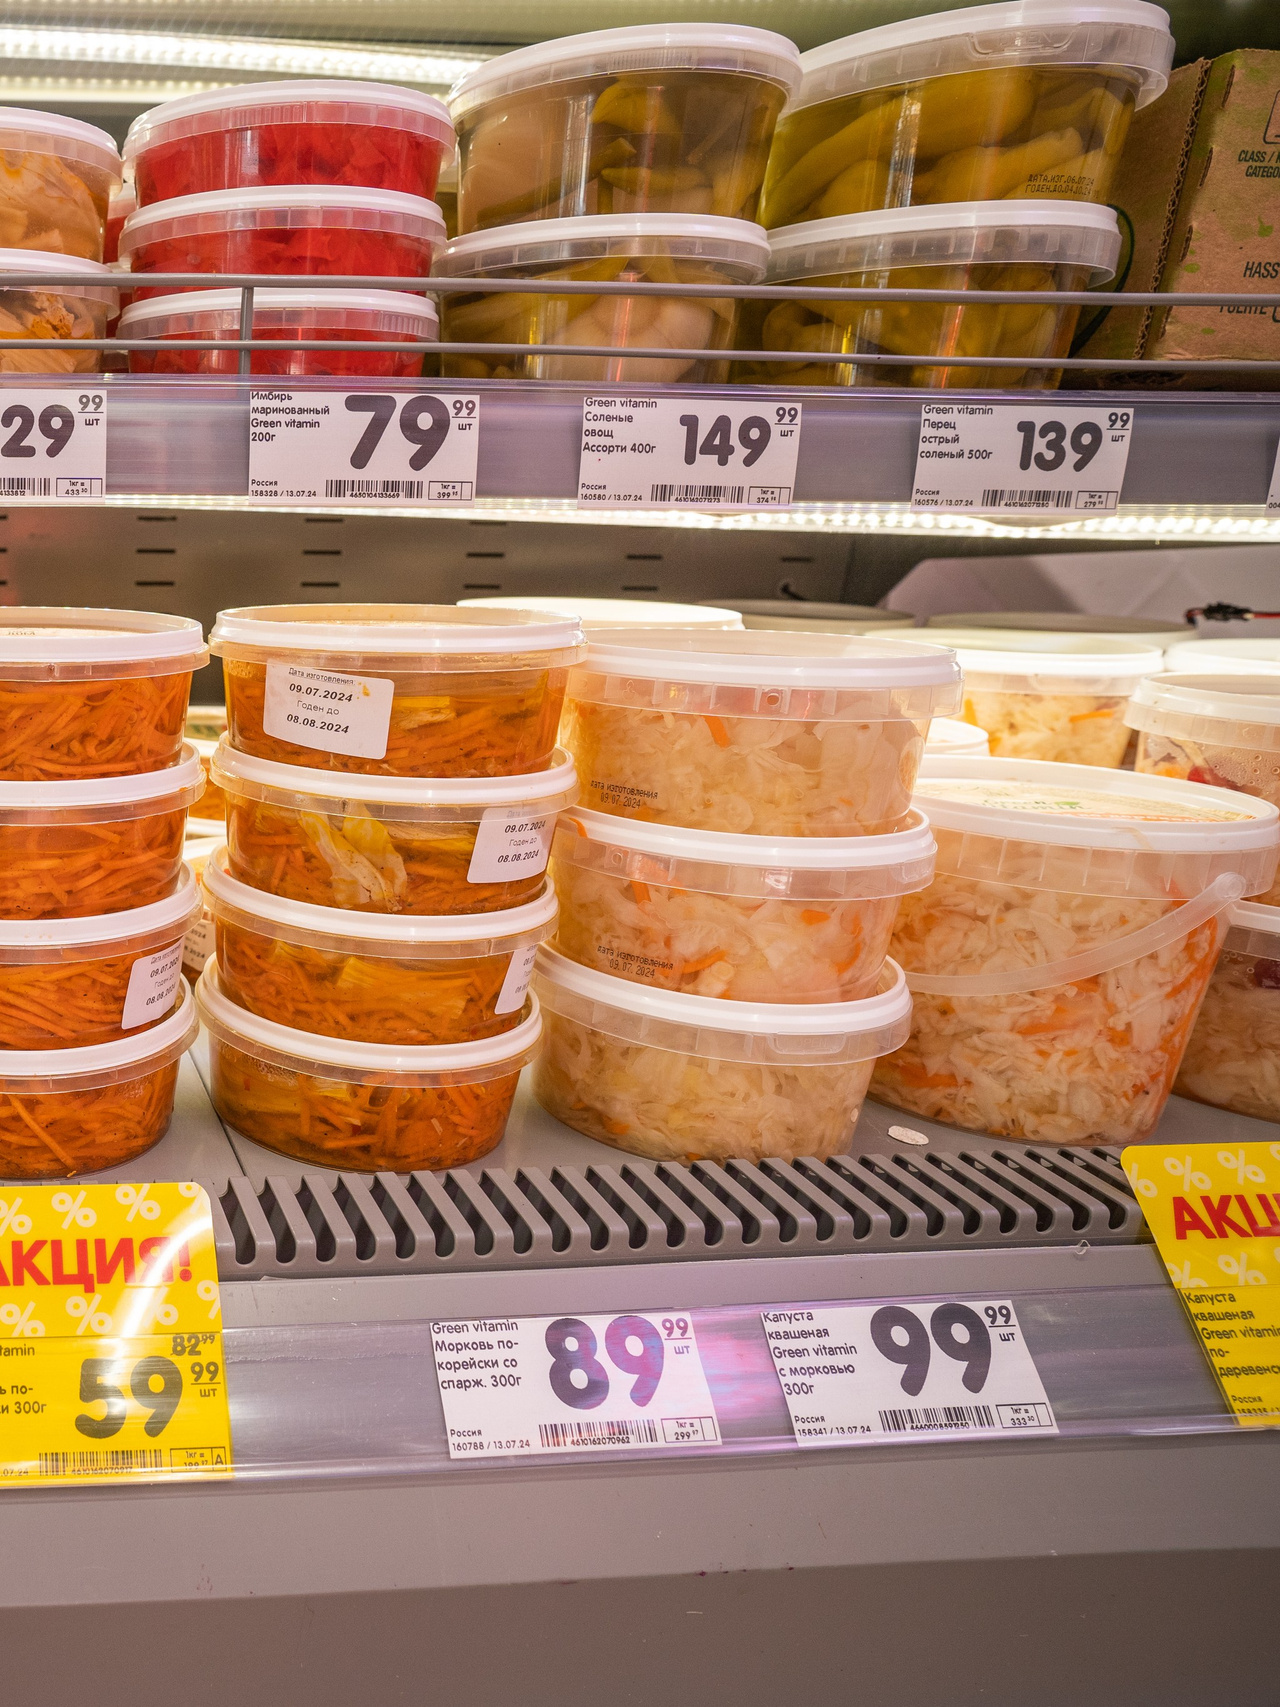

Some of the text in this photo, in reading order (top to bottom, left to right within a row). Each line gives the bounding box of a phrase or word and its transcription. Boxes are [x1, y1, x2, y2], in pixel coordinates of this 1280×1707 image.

[1238, 150, 1266, 162] CLASS
[1245, 165, 1280, 178] CATEGO
[1243, 261, 1280, 278] HASS
[79, 395, 103, 411] 99
[251, 392, 292, 401] Имбирь
[585, 398, 657, 408] Green vitamin
[251, 406, 329, 416] маринованный
[923, 405, 993, 415] Green vitamin
[85, 418, 100, 426] шт
[251, 419, 320, 428] Green vitamin
[585, 412, 633, 423] Соленые
[923, 419, 956, 430] Перец
[251, 432, 275, 442] 200г
[345, 395, 476, 471] 79 99
[584, 429, 613, 438] овощ
[680, 407, 798, 467] 149 99
[922, 434, 959, 445] острый
[1111, 434, 1124, 442] шт
[583, 442, 656, 455] Ассорти 400г
[1017, 412, 1130, 472] 139 99
[920, 449, 992, 459] соленый 500г
[289, 683, 353, 702] 09.07.2024
[297, 700, 339, 716] Годен до
[286, 713, 349, 734] 08.08.2024
[505, 820, 546, 833] 09.07.2024
[498, 850, 539, 863] 08.08.2024
[1173, 1193, 1280, 1240] АКЦ
[1185, 1292, 1236, 1305] Капуста
[764, 1311, 813, 1324] Капуста
[1193, 1309, 1254, 1321] квашеная
[432, 1320, 518, 1334] Green vitamin
[1201, 1327, 1238, 1340] Green
[768, 1328, 829, 1340] квашеная
[999, 1332, 1015, 1342] шт
[435, 1339, 518, 1352] Морковь по-
[674, 1346, 690, 1354] шт
[773, 1344, 857, 1359] Green vitamin
[870, 1302, 1011, 1396] 99 99
[1210, 1347, 1230, 1357] по-
[438, 1358, 517, 1372] корейски со
[545, 1315, 688, 1410] 89 99
[790, 1364, 854, 1378] морковью
[441, 1375, 521, 1390] спарж. 300г
[784, 1382, 814, 1396] 300г
[11, 1384, 33, 1395] по-
[200, 1388, 217, 1398] шт
[75, 1356, 219, 1439] 59 99
[14, 1402, 46, 1414] 300г
